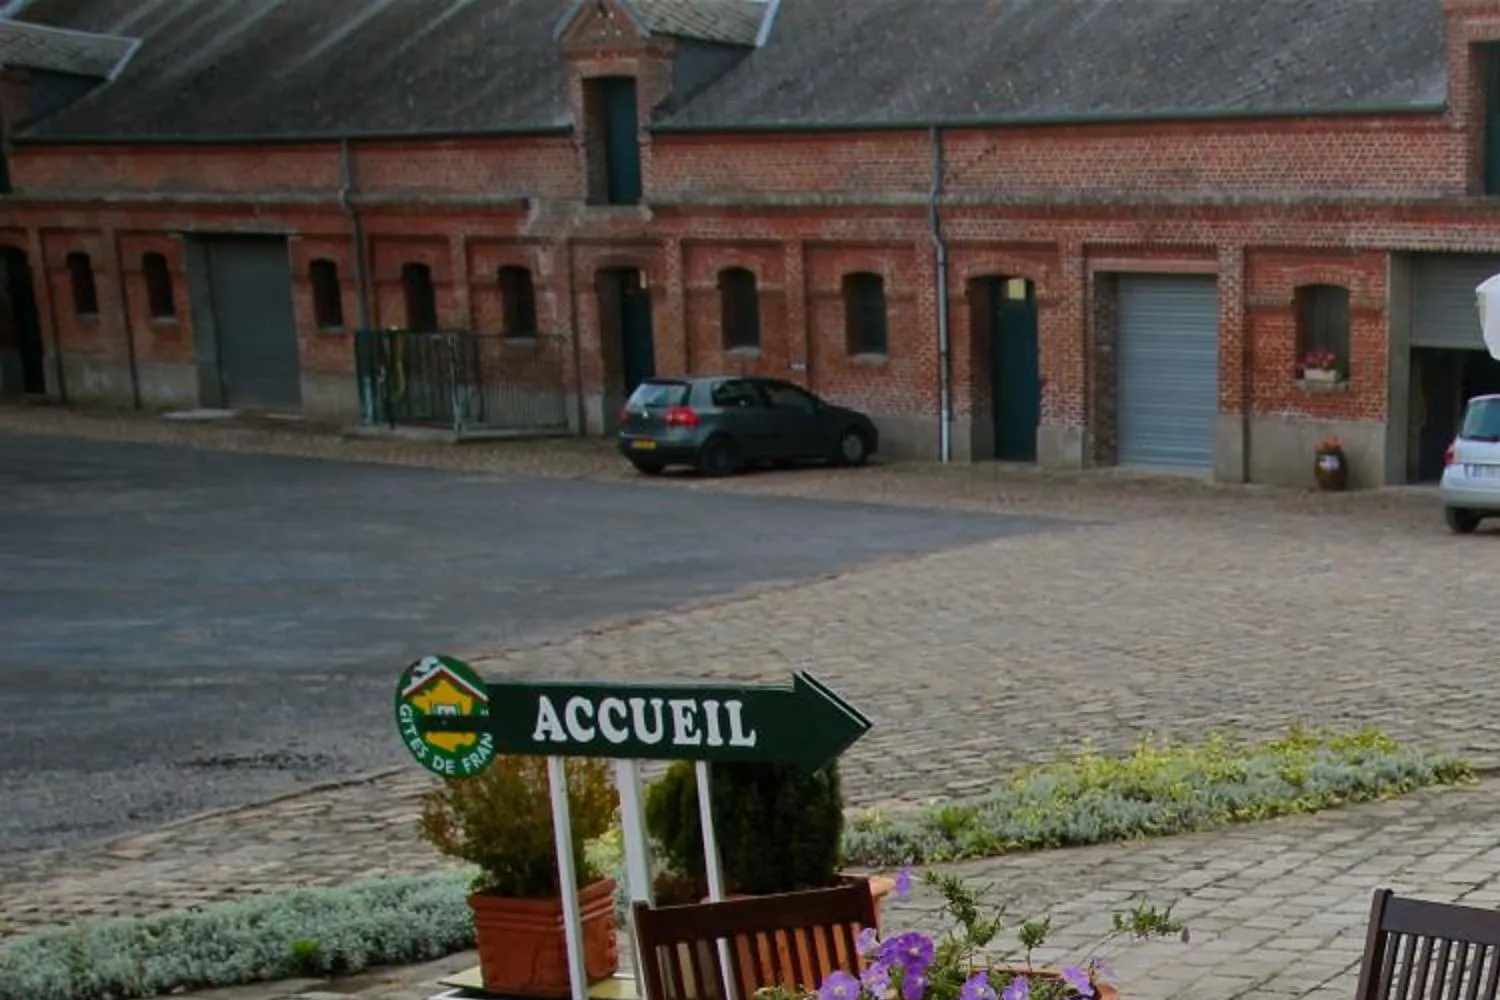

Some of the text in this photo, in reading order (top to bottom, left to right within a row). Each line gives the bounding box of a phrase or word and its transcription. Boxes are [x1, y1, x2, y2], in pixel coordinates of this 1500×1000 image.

[432, 756, 455, 774] DE
[461, 707, 493, 773] FRANE
[532, 694, 757, 747] ACCUEIL
